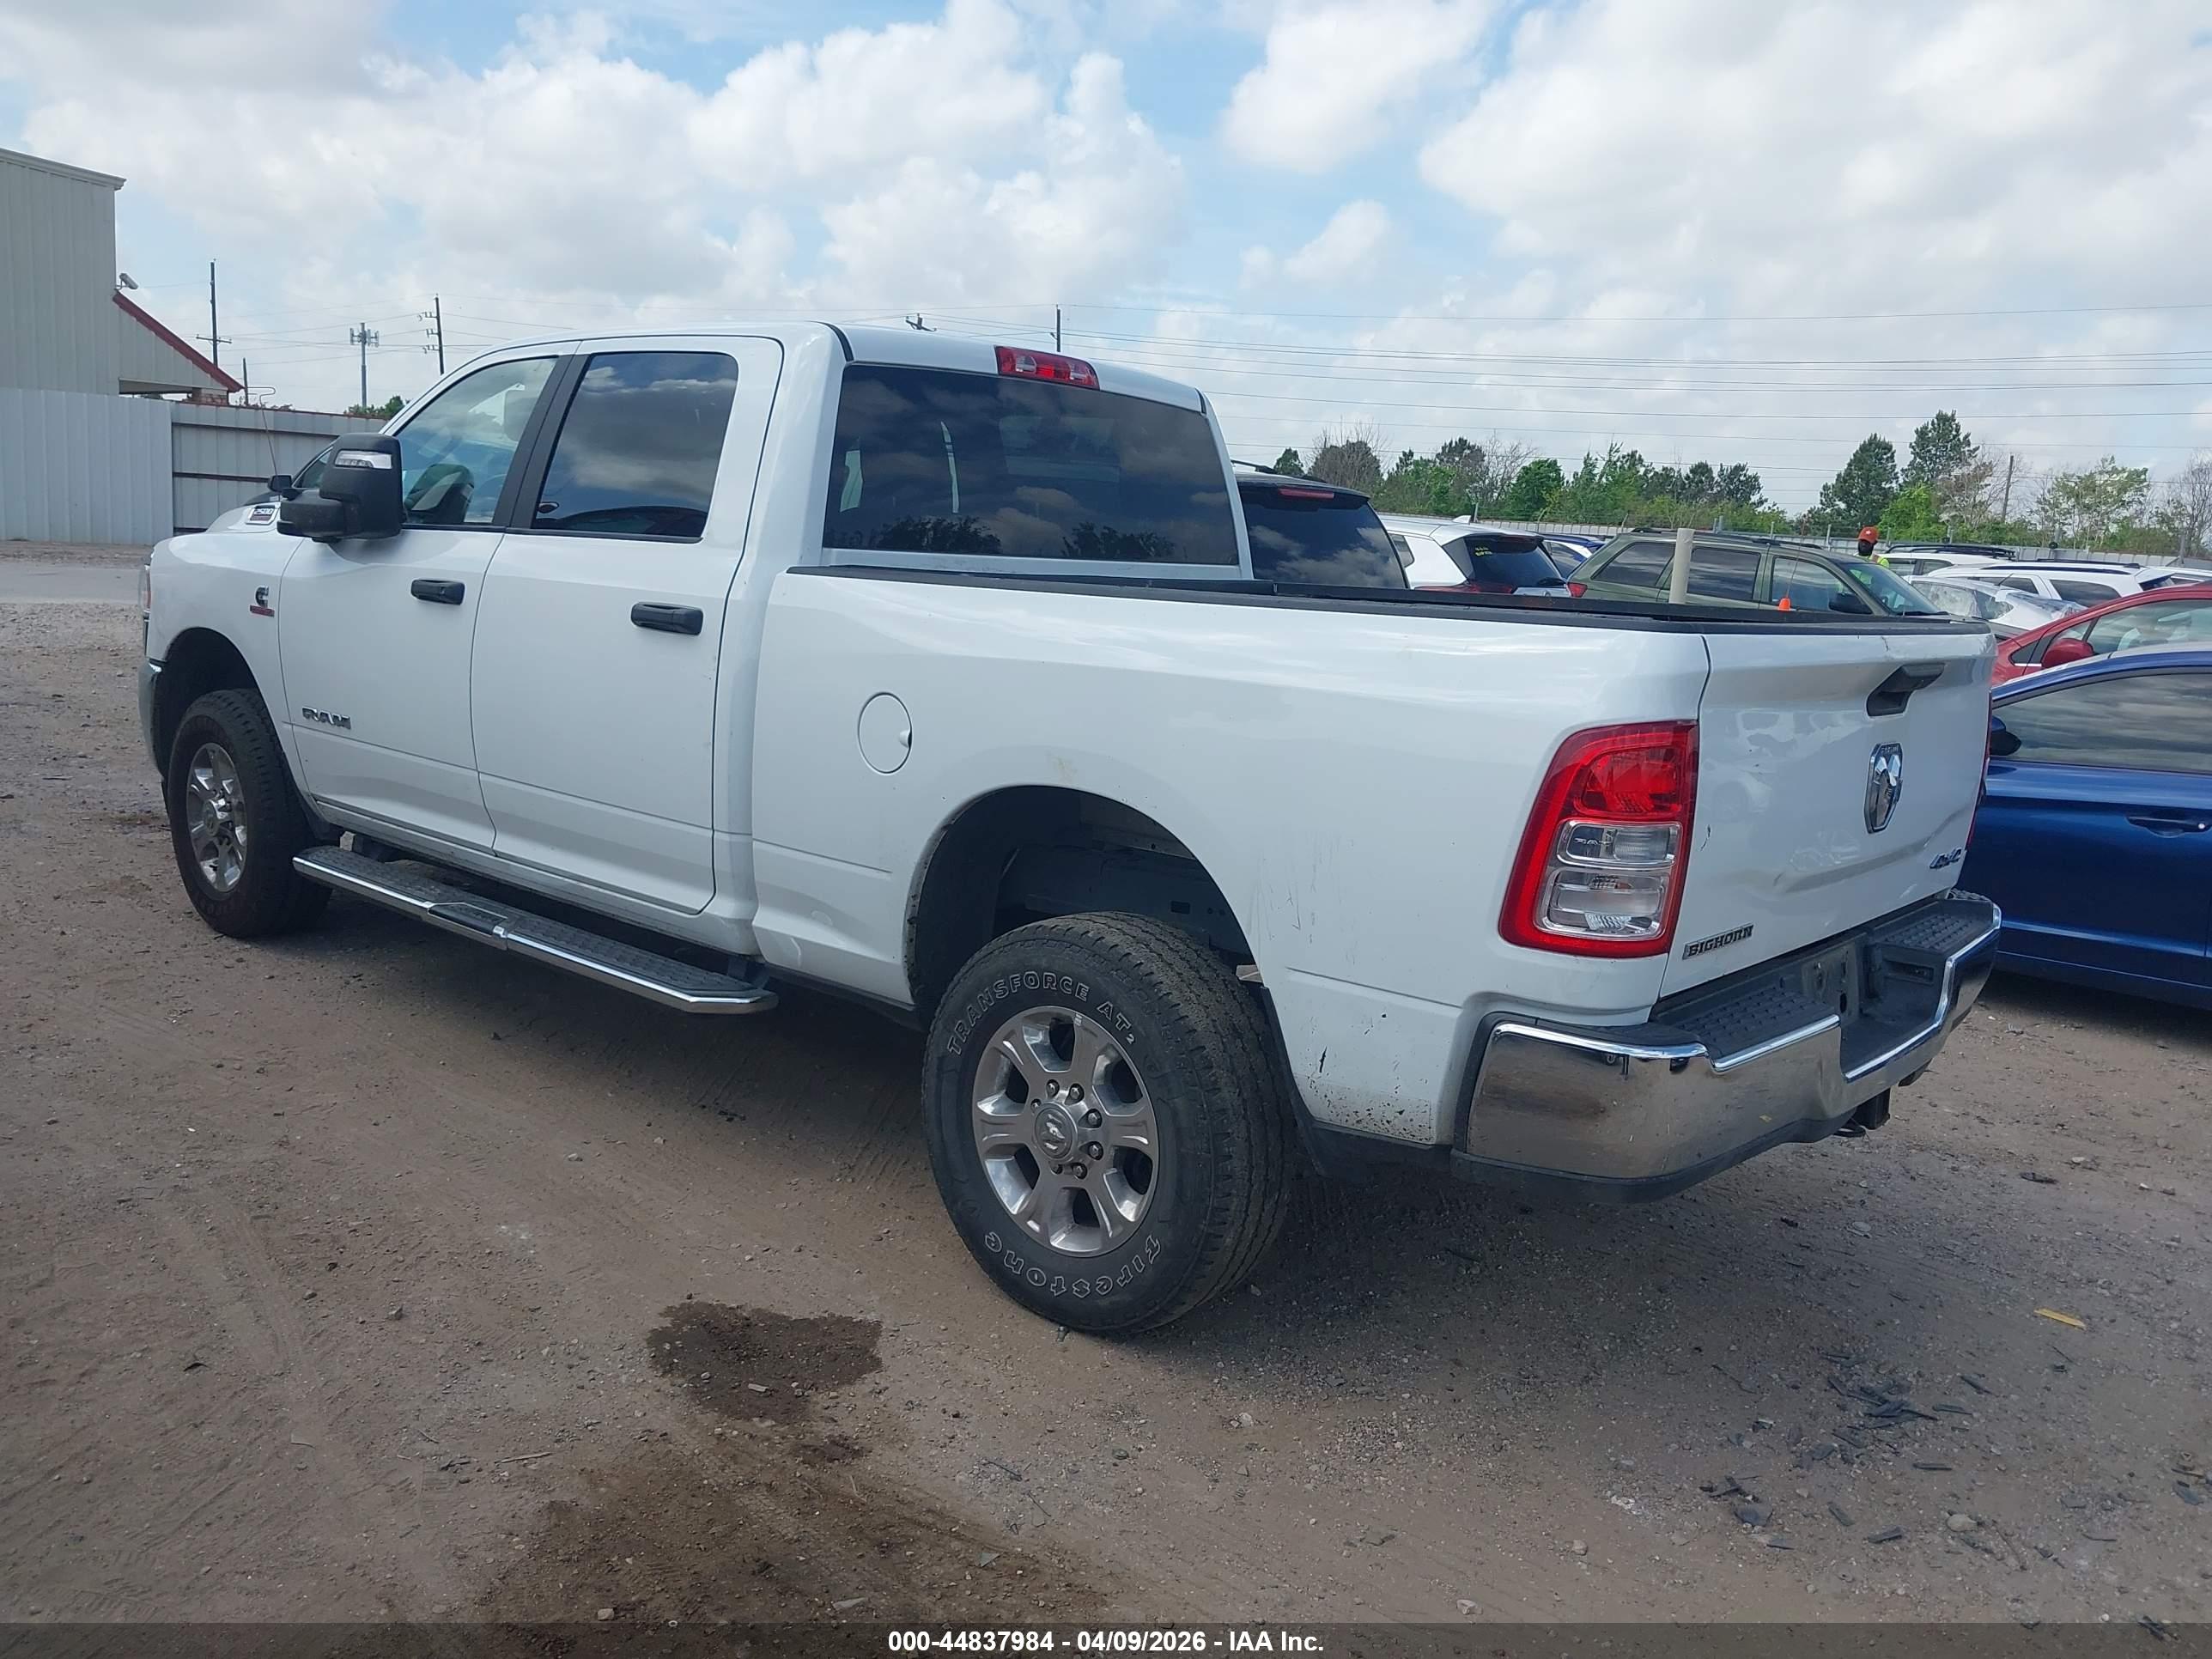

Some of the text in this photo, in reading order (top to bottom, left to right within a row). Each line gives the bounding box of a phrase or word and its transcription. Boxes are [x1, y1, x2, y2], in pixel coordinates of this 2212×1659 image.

[301, 706, 351, 730] RAM
[1686, 924, 1754, 957] BIGHORN
[946, 970, 1090, 1055] TRANSFORCE
[984, 1231, 1161, 1298] Firestone
